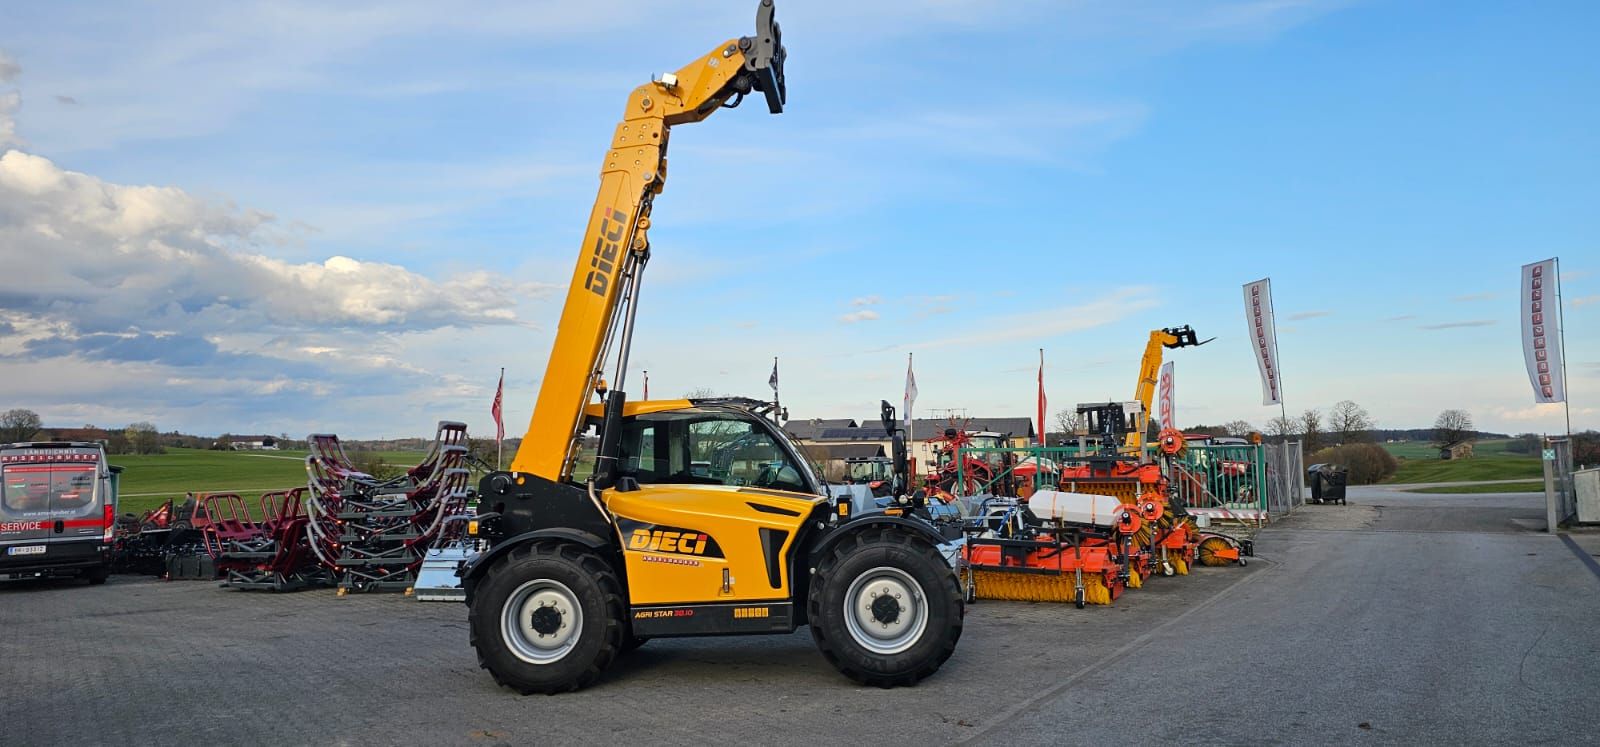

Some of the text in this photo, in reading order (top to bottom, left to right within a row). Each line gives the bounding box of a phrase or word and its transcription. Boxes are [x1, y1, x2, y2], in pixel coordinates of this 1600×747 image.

[585, 207, 627, 297] DIECI
[0, 521, 41, 531] SERVICE
[629, 529, 708, 554] DIECI
[654, 610, 673, 618] STAR
